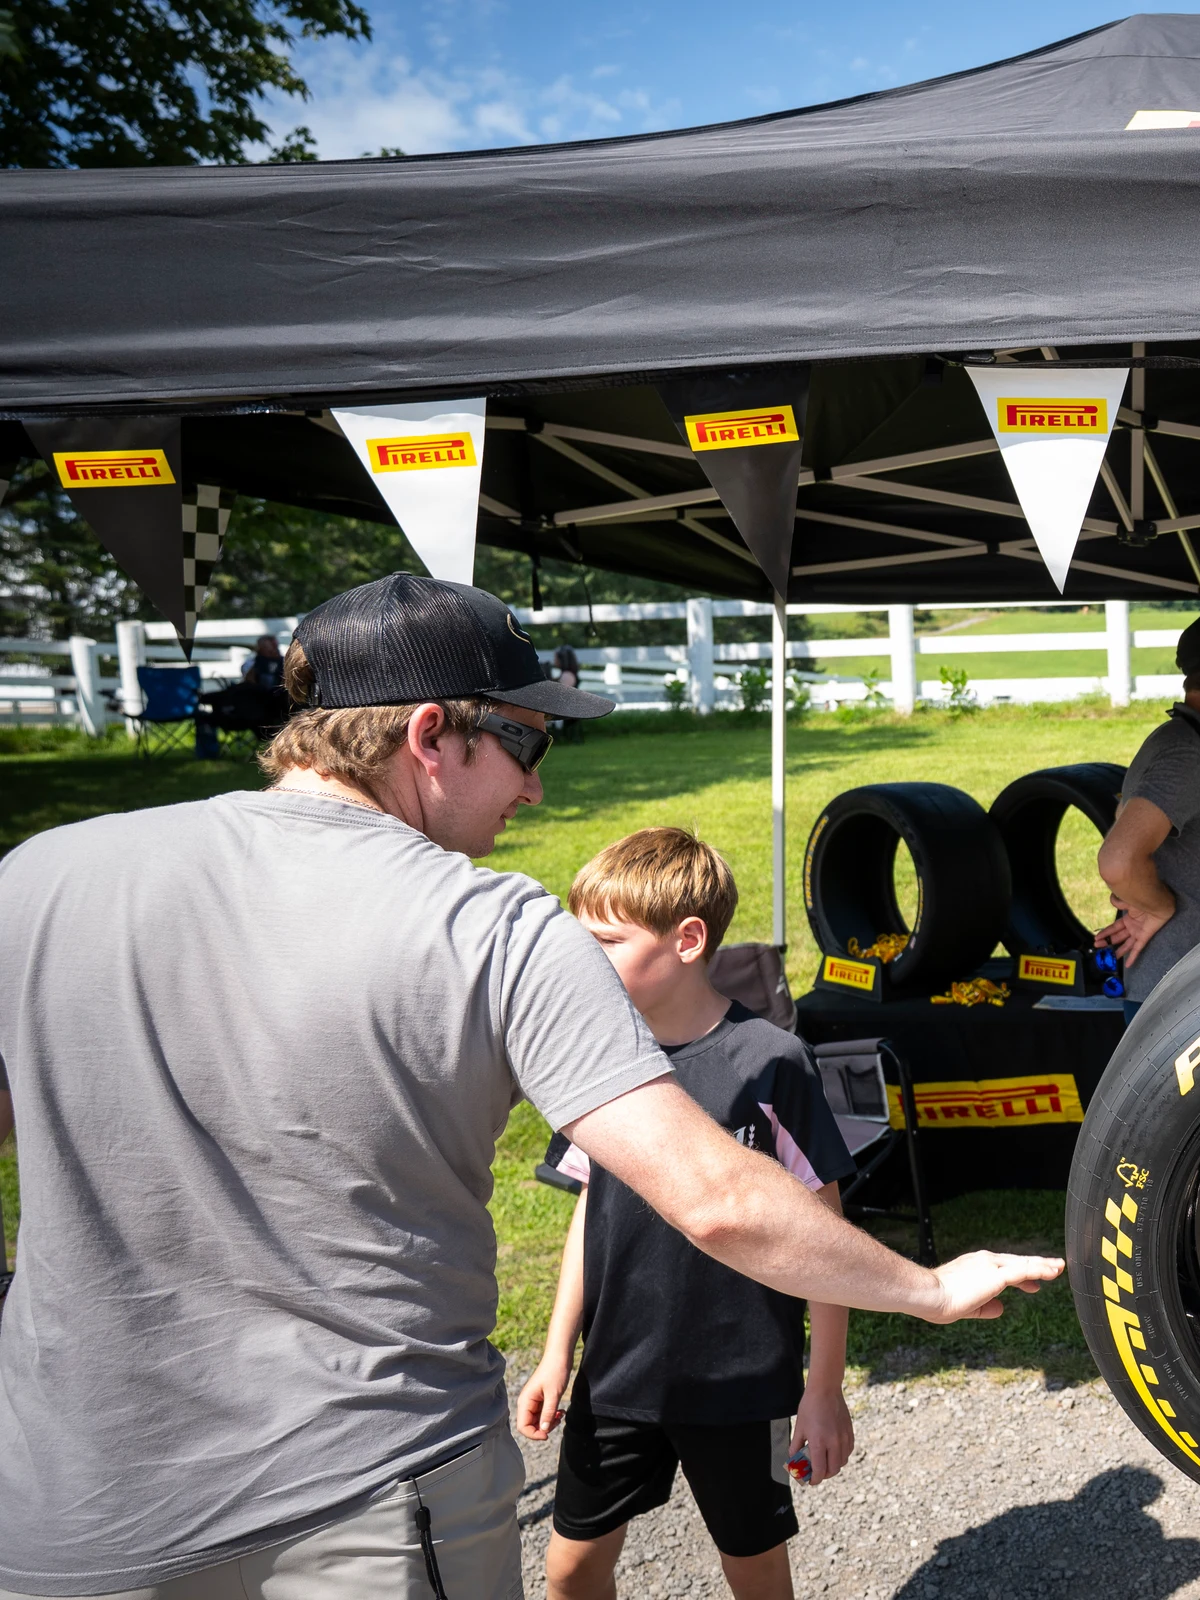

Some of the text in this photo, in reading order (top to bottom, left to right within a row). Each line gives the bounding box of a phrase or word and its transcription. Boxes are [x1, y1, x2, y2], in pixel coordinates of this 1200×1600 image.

[1006, 404, 1098, 427] PIRELLI
[696, 413, 787, 443] PIRELLI
[376, 439, 466, 466] PIRELLI
[64, 457, 161, 481] PIRELLI
[829, 962, 870, 984] PIRELLI
[1024, 960, 1070, 980] PIRELLI
[1136, 1168, 1149, 1189] FSC
